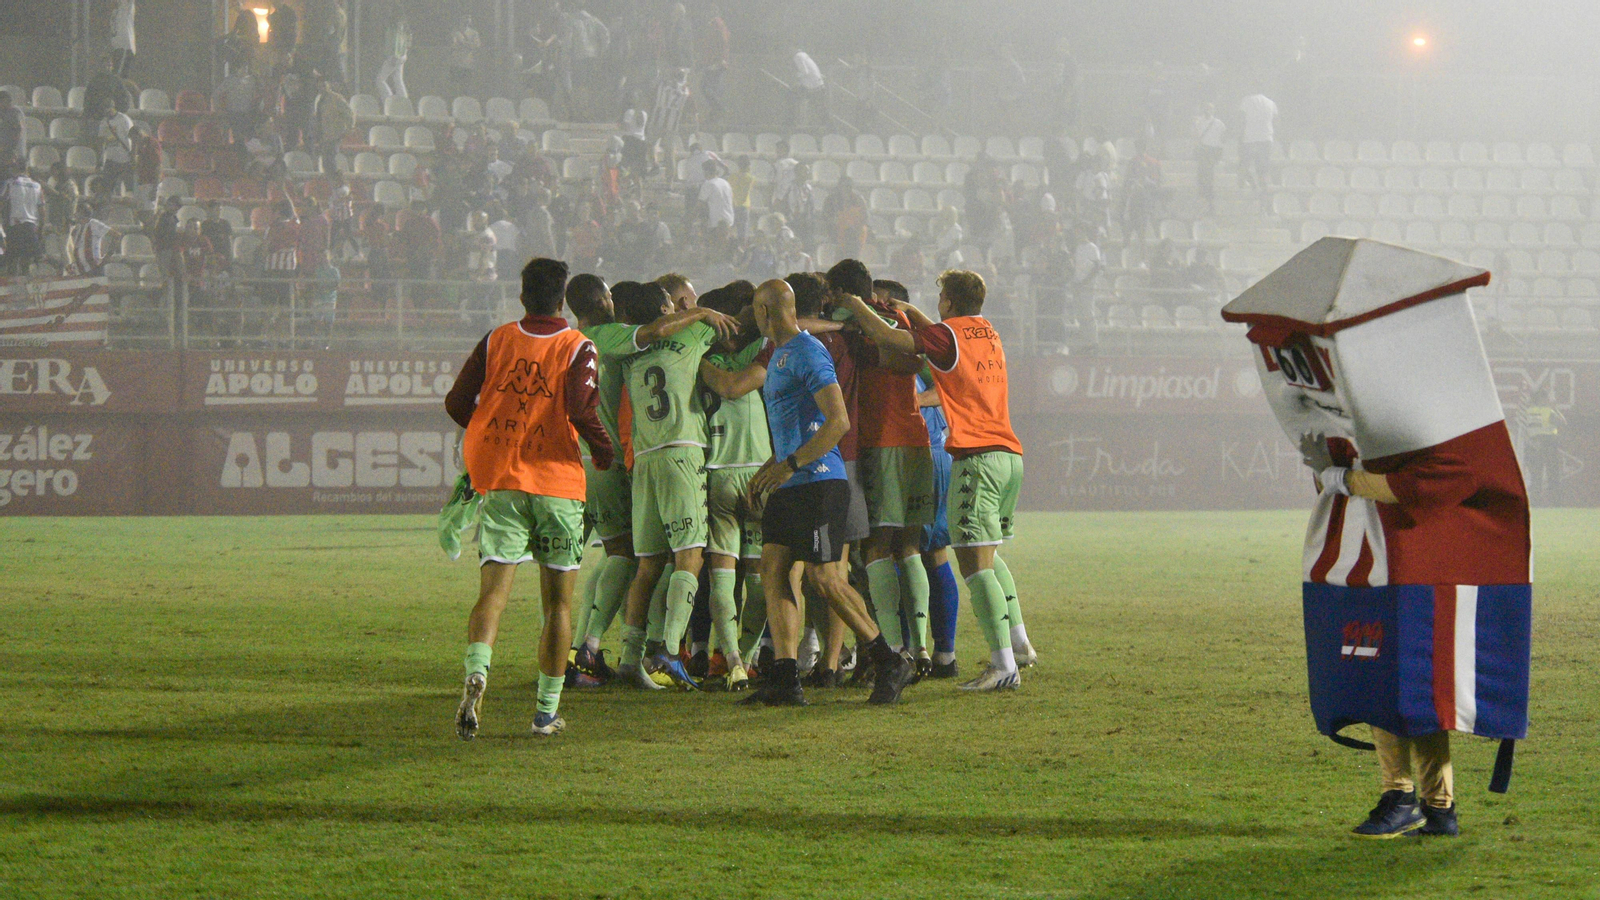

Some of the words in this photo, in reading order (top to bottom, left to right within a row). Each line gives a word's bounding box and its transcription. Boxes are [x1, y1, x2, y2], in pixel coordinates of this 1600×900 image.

[646, 340, 686, 355] OPEZ
[210, 359, 314, 372] UNIVERSO
[350, 360, 451, 373] UNIVERSO
[0, 358, 112, 406] ERA
[205, 373, 319, 395] APOLO
[344, 373, 455, 396] APOLO
[1087, 366, 1221, 408] Limpiasol
[643, 365, 671, 423] 3
[483, 435, 543, 452] HOTEES
[220, 431, 458, 488] ALGES
[670, 517, 694, 533] CJR
